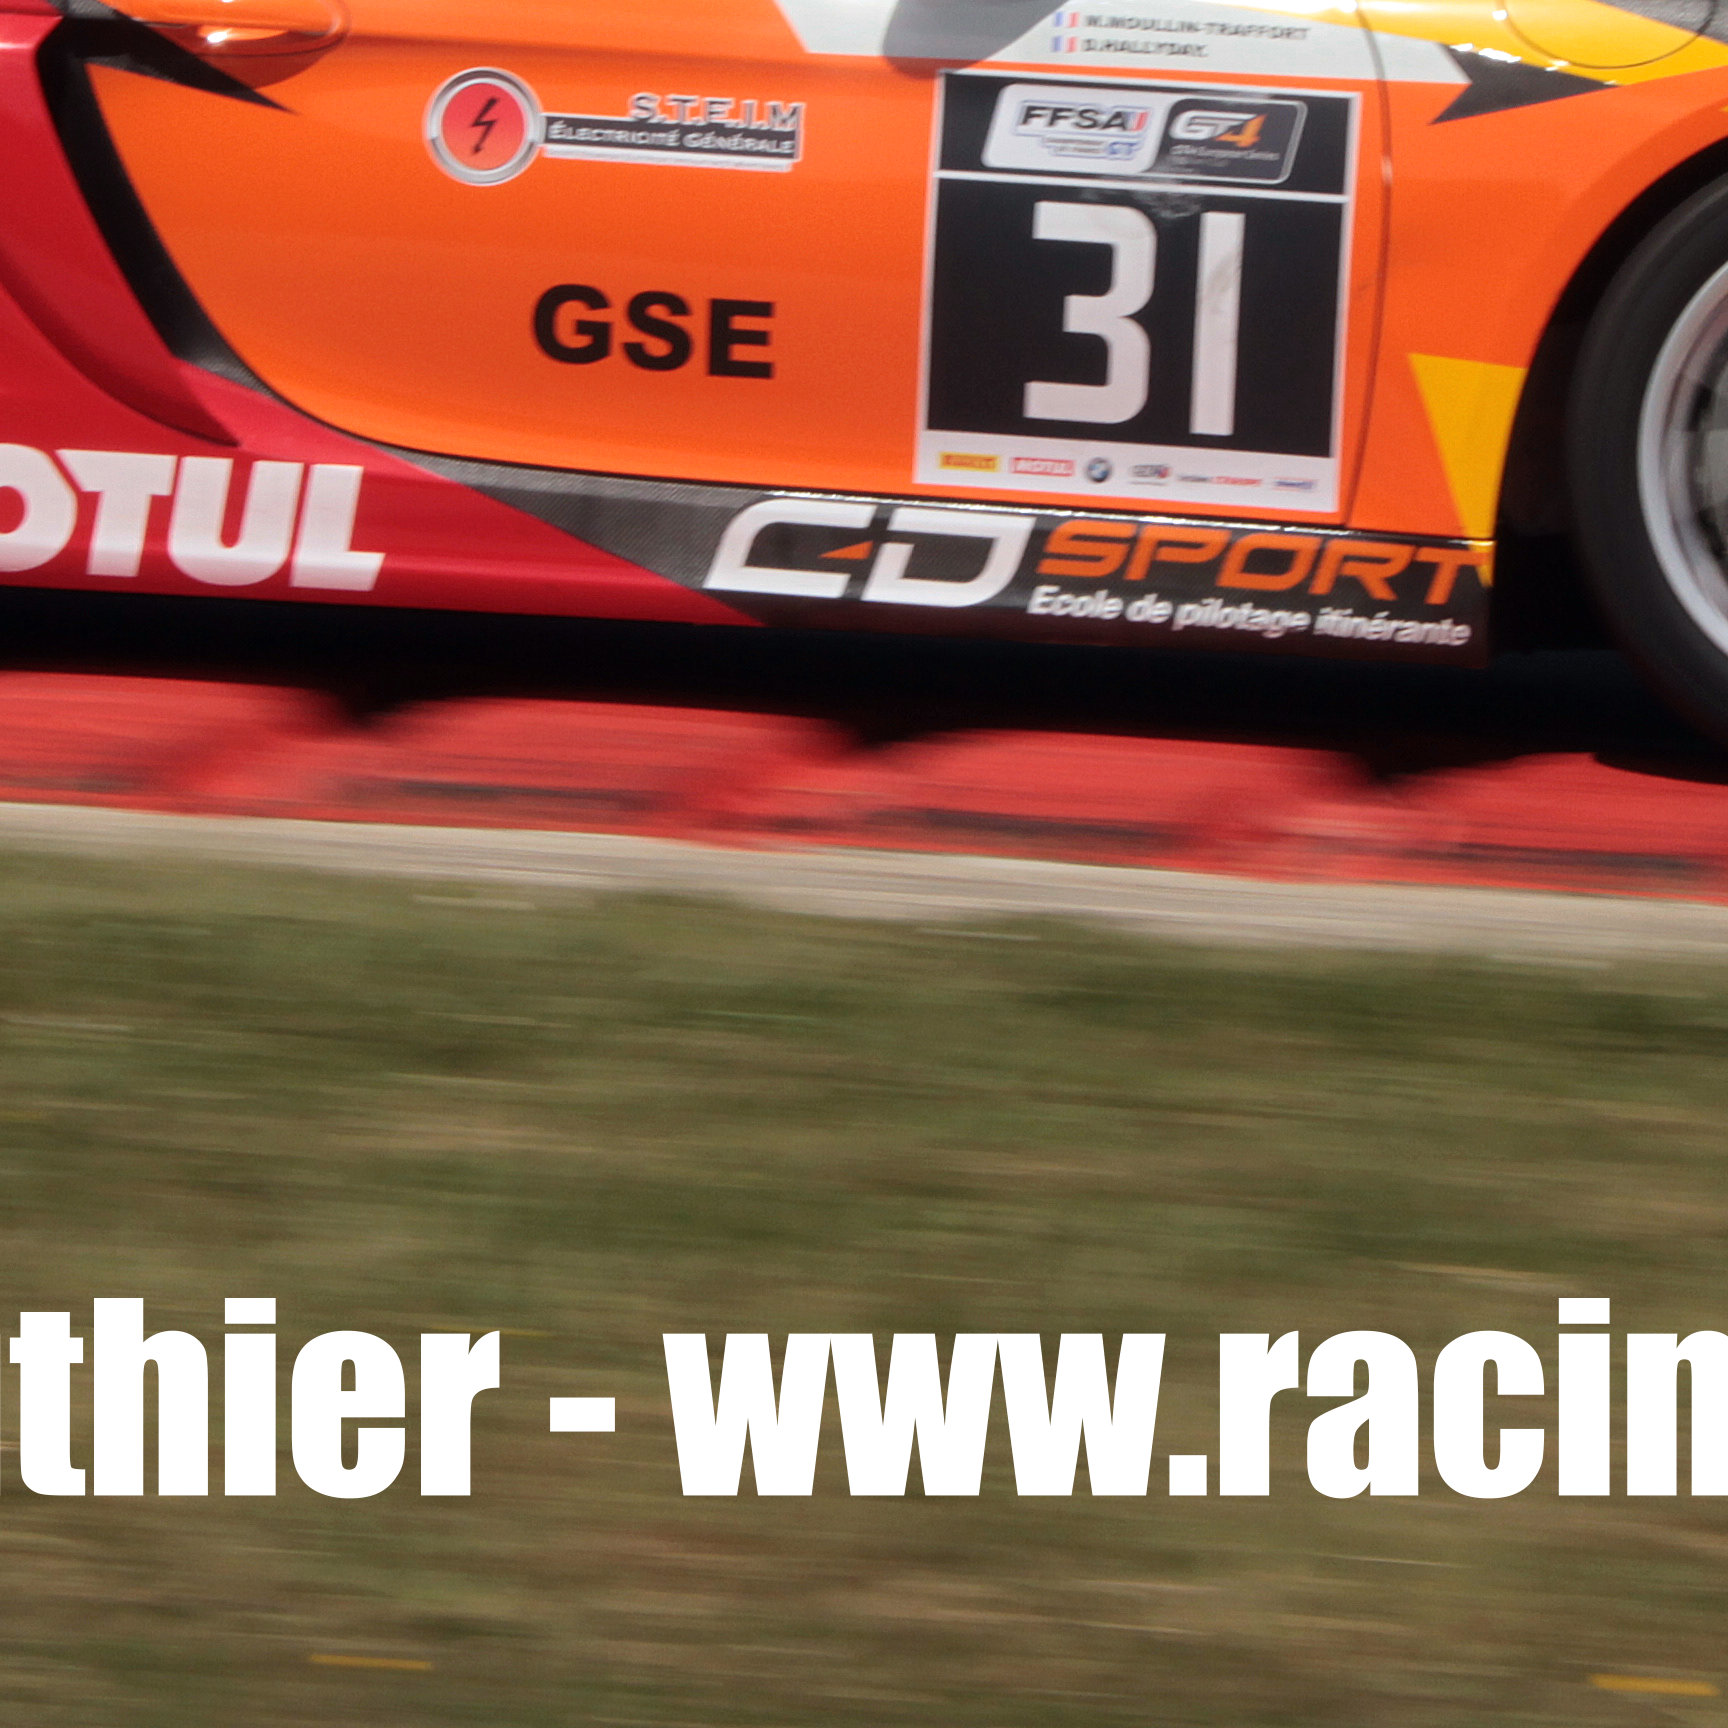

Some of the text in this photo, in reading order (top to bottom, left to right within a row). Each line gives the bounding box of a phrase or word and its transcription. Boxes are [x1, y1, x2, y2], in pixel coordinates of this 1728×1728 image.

[1022, 105, 1267, 148] FFSA GT4
[532, 284, 777, 379] GSE
[1023, 201, 1246, 436] 31
[1036, 520, 1490, 605] SPORT
[1027, 585, 1472, 647] Ecole de pilotage itinérante
